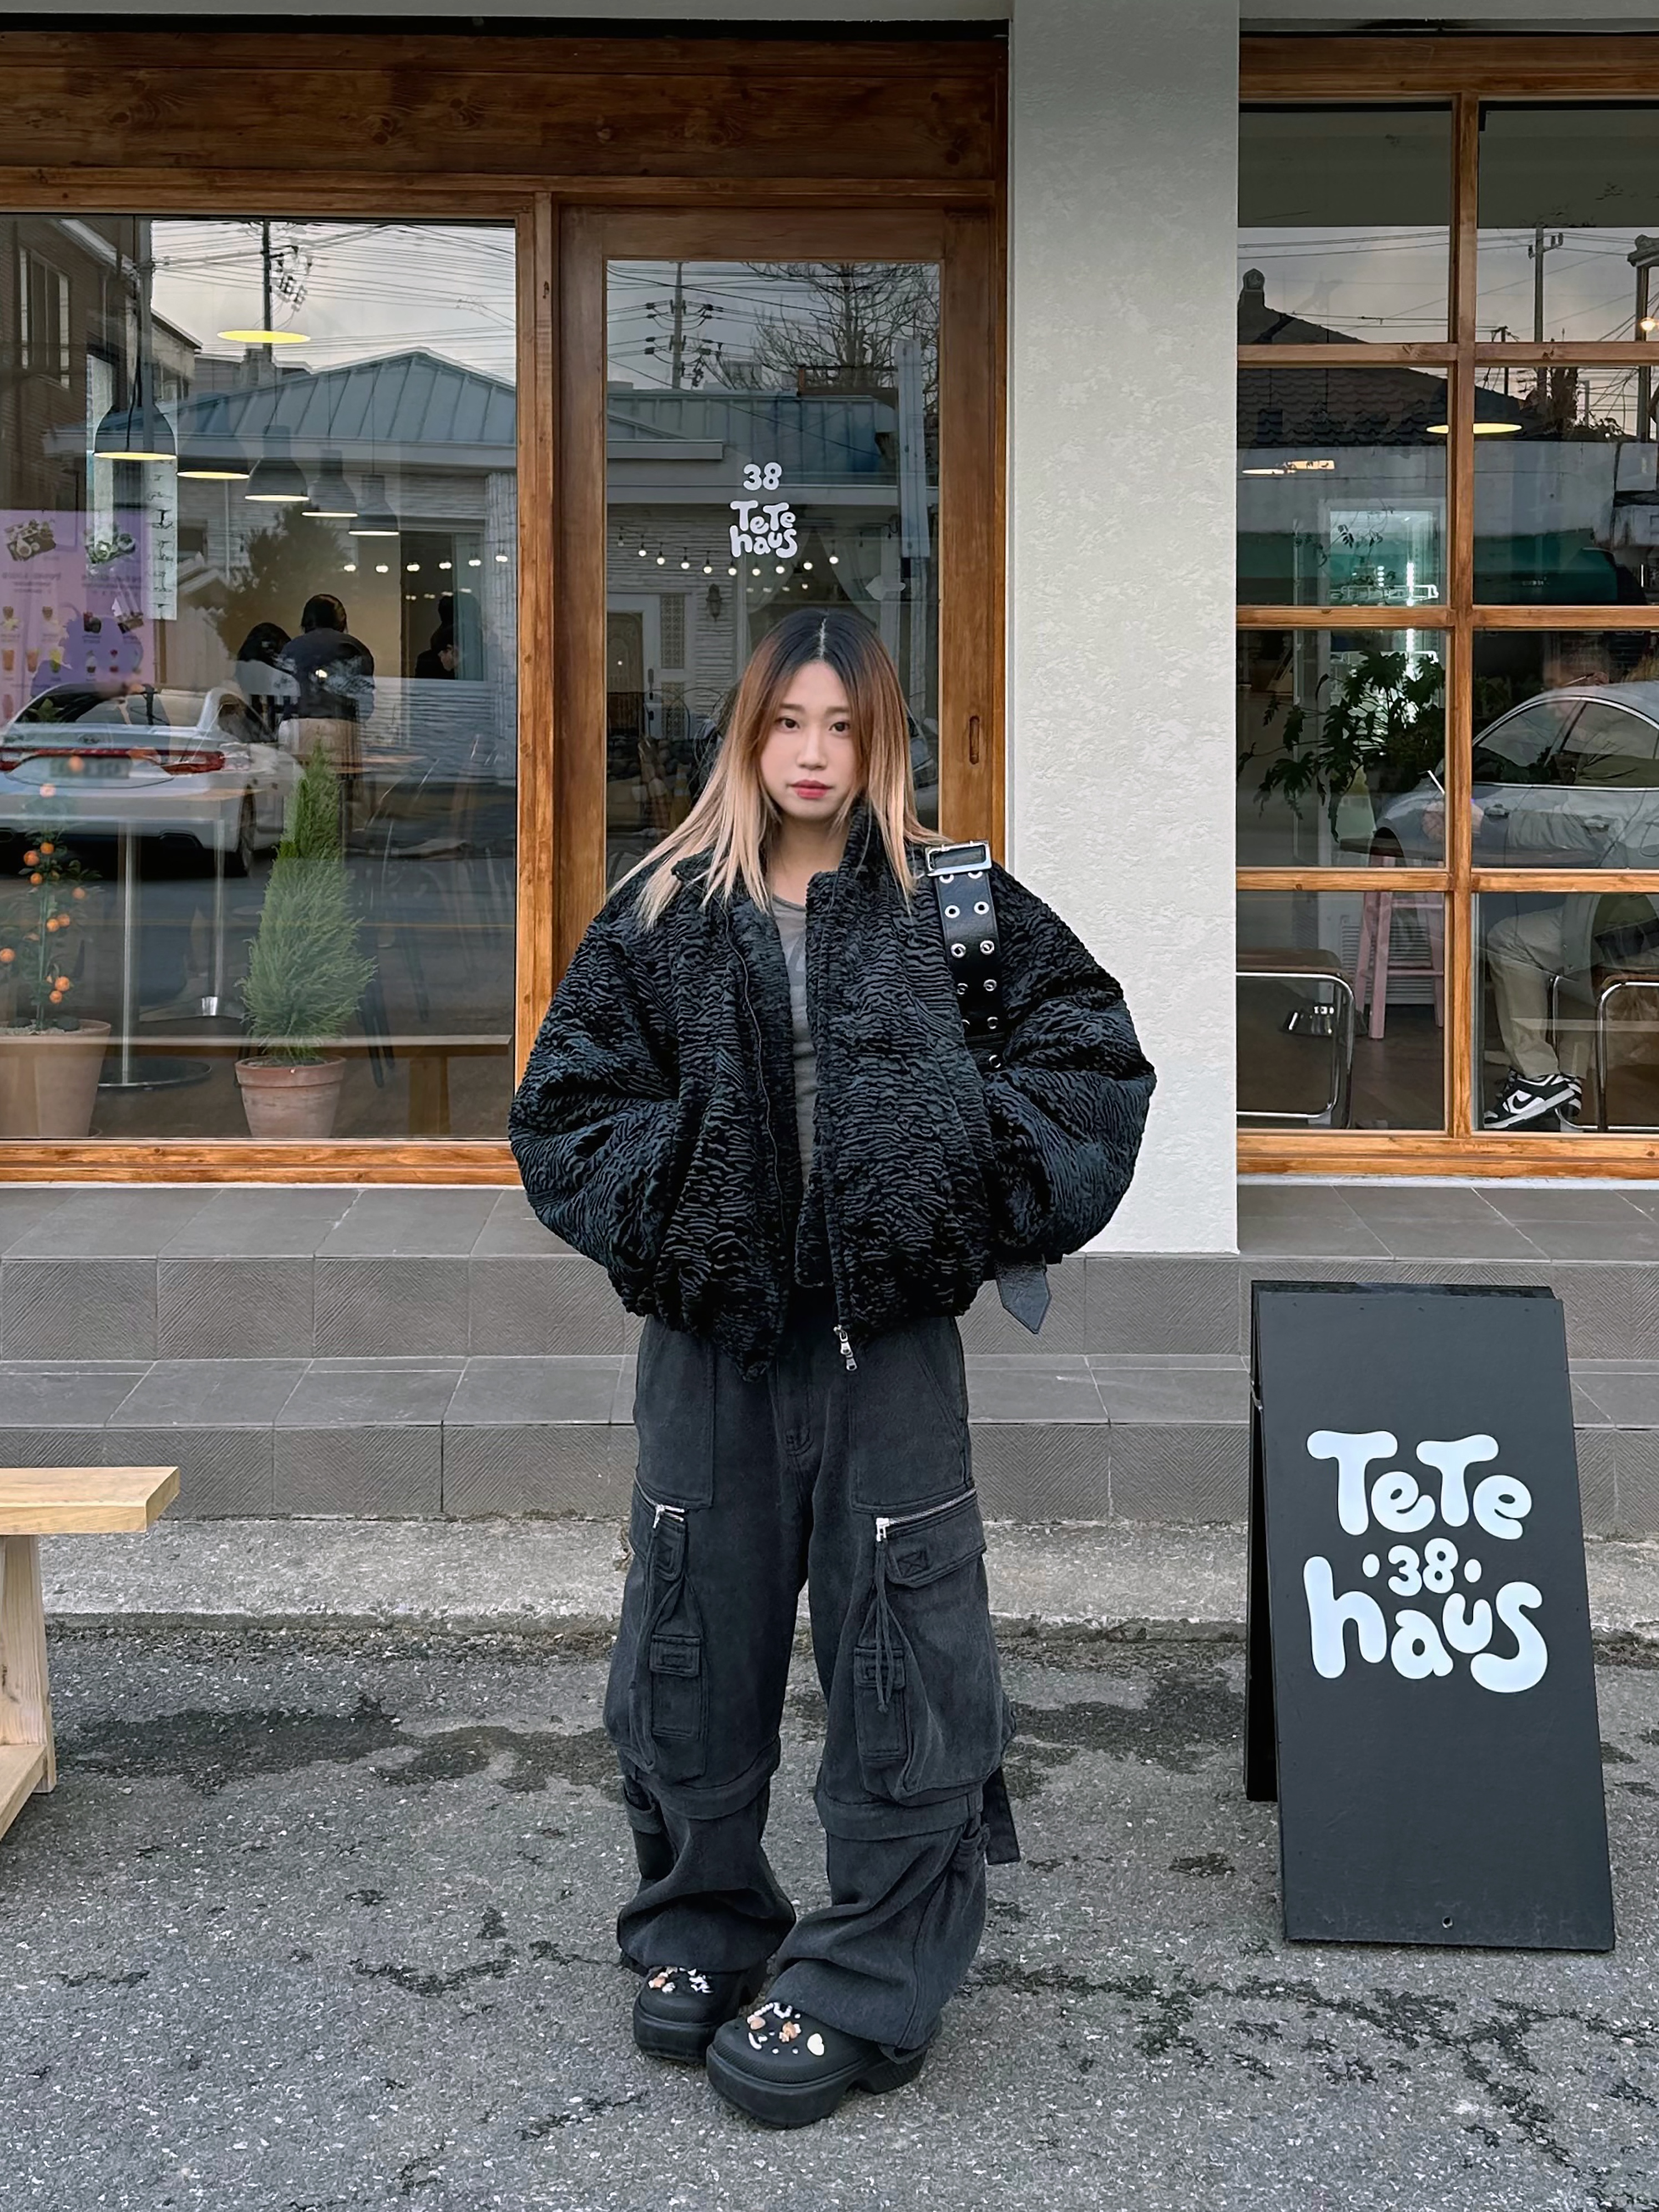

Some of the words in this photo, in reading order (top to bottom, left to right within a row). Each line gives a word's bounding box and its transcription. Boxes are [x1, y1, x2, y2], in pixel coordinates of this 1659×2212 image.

[743, 462, 782, 491] 38
[730, 525, 798, 558] haus
[1303, 1556, 1548, 1694] haus
